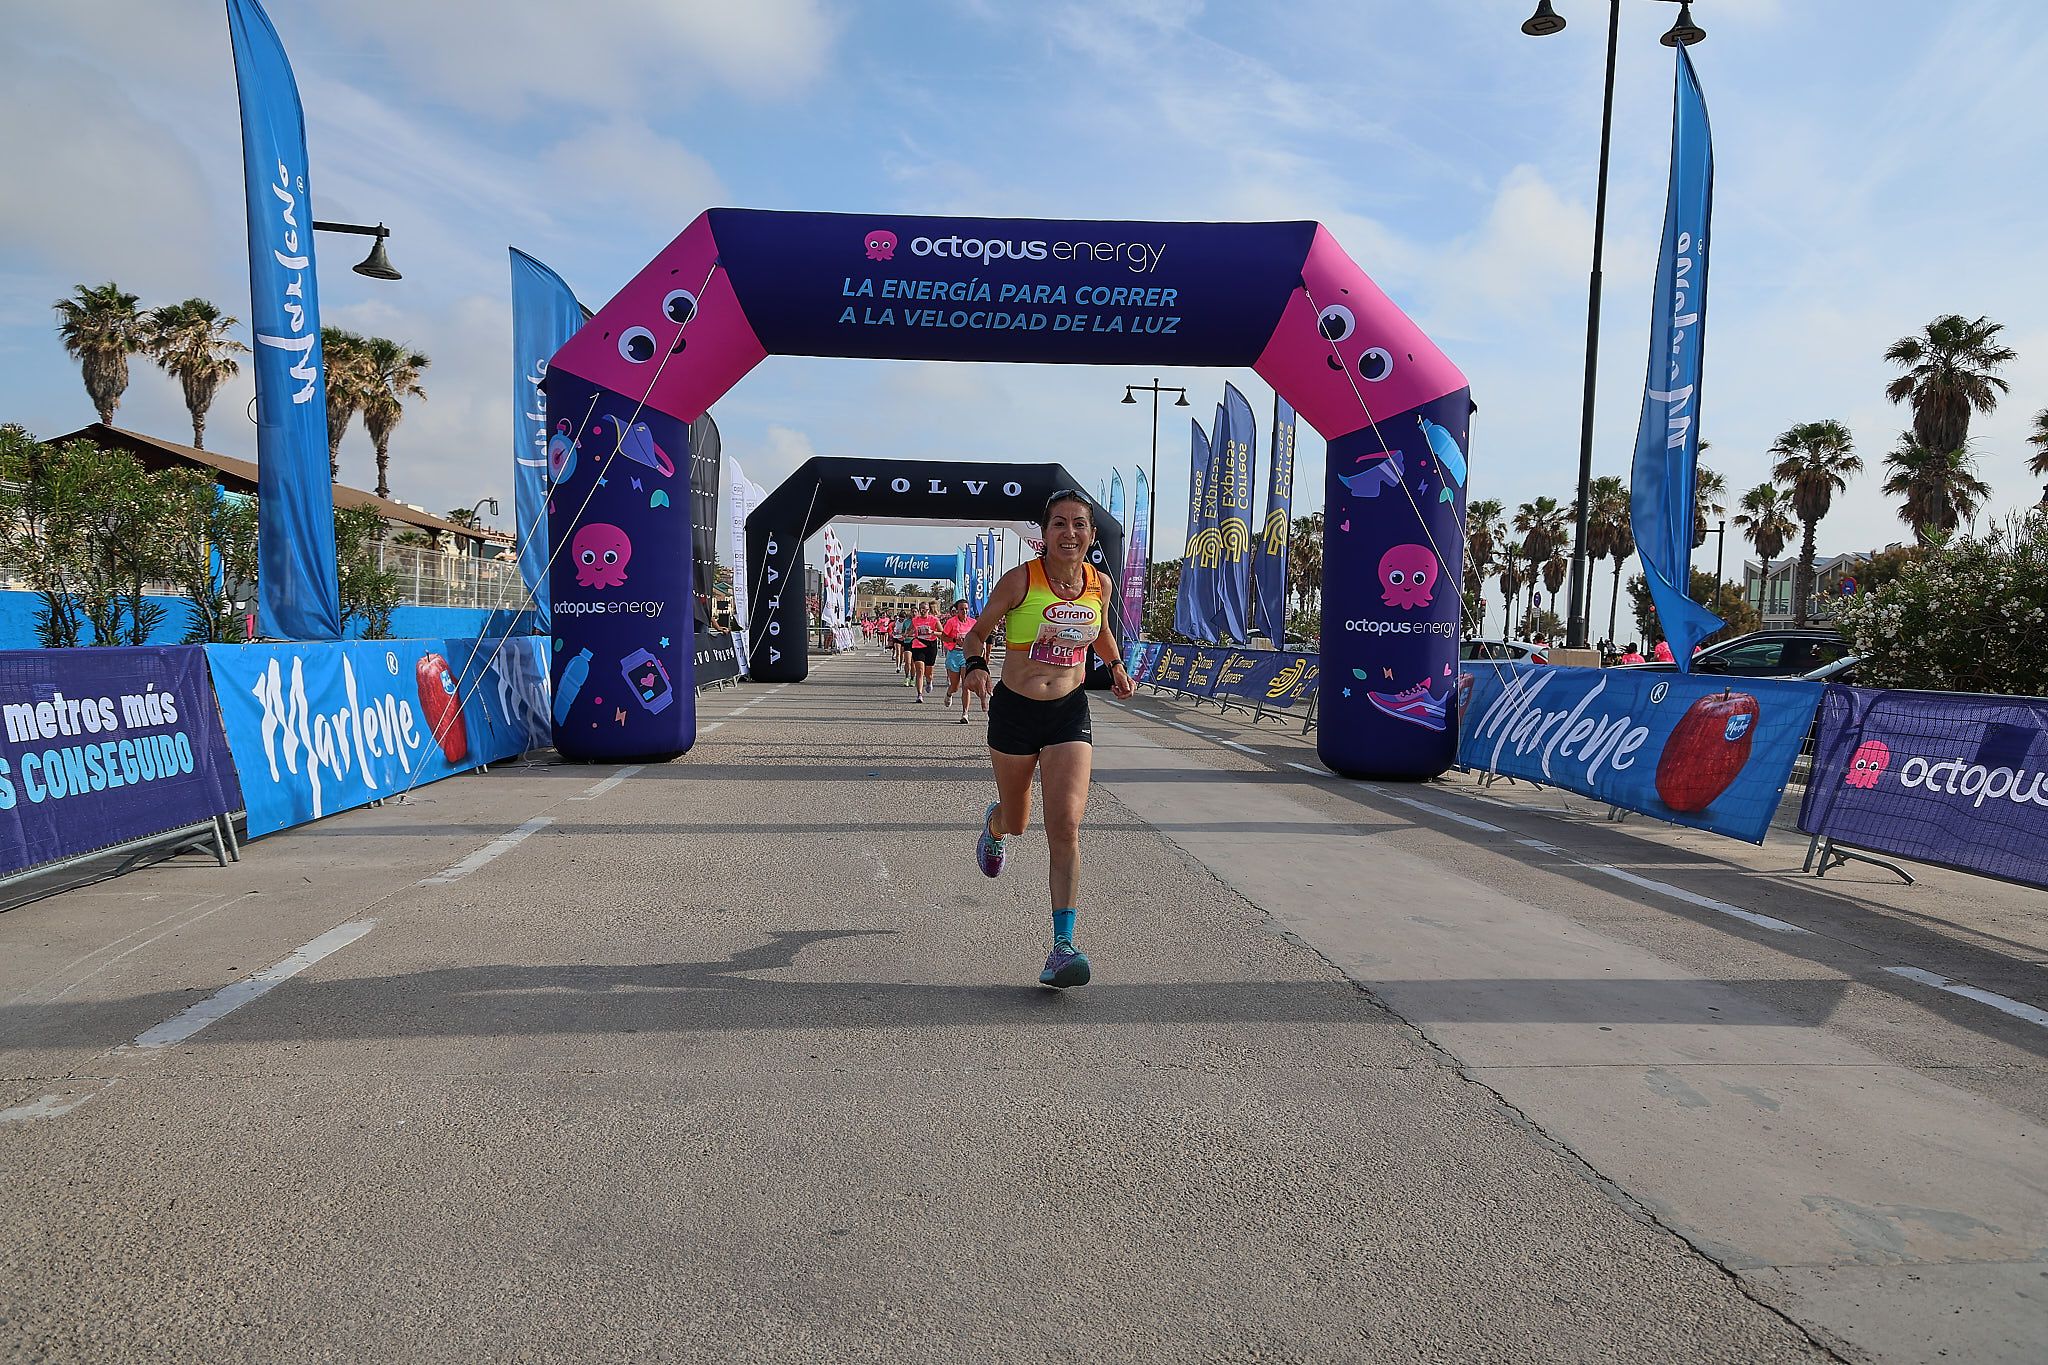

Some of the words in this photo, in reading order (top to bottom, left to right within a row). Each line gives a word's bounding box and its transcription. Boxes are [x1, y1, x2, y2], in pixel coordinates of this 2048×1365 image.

[911, 235, 1048, 266] octopus
[1052, 241, 1166, 273] energy
[842, 277, 874, 298] LA
[881, 278, 992, 302] ENERGÍA
[998, 283, 1068, 305] PARA
[1075, 286, 1178, 307] CORRER
[838, 306, 857, 324] A
[863, 308, 896, 326] LA
[904, 309, 1047, 331] VELOCIDAD
[1053, 314, 1087, 332] DE
[1092, 315, 1124, 333] LA
[1130, 316, 1181, 334] LUZ
[850, 475, 1022, 497] VOLVO
[885, 555, 929, 575] Marlene
[554, 600, 606, 617] octopus
[607, 601, 665, 617] energy
[767, 540, 781, 664] VOLVO
[1048, 607, 1094, 619] Serrano
[1345, 619, 1411, 636] octopus
[1413, 622, 1456, 638] energy
[2, 692, 119, 743] metros
[120, 682, 179, 730] más
[1474, 668, 1650, 786] Marlene
[251, 651, 420, 820] Marlene
[21, 731, 195, 804] CONSEGUIDO
